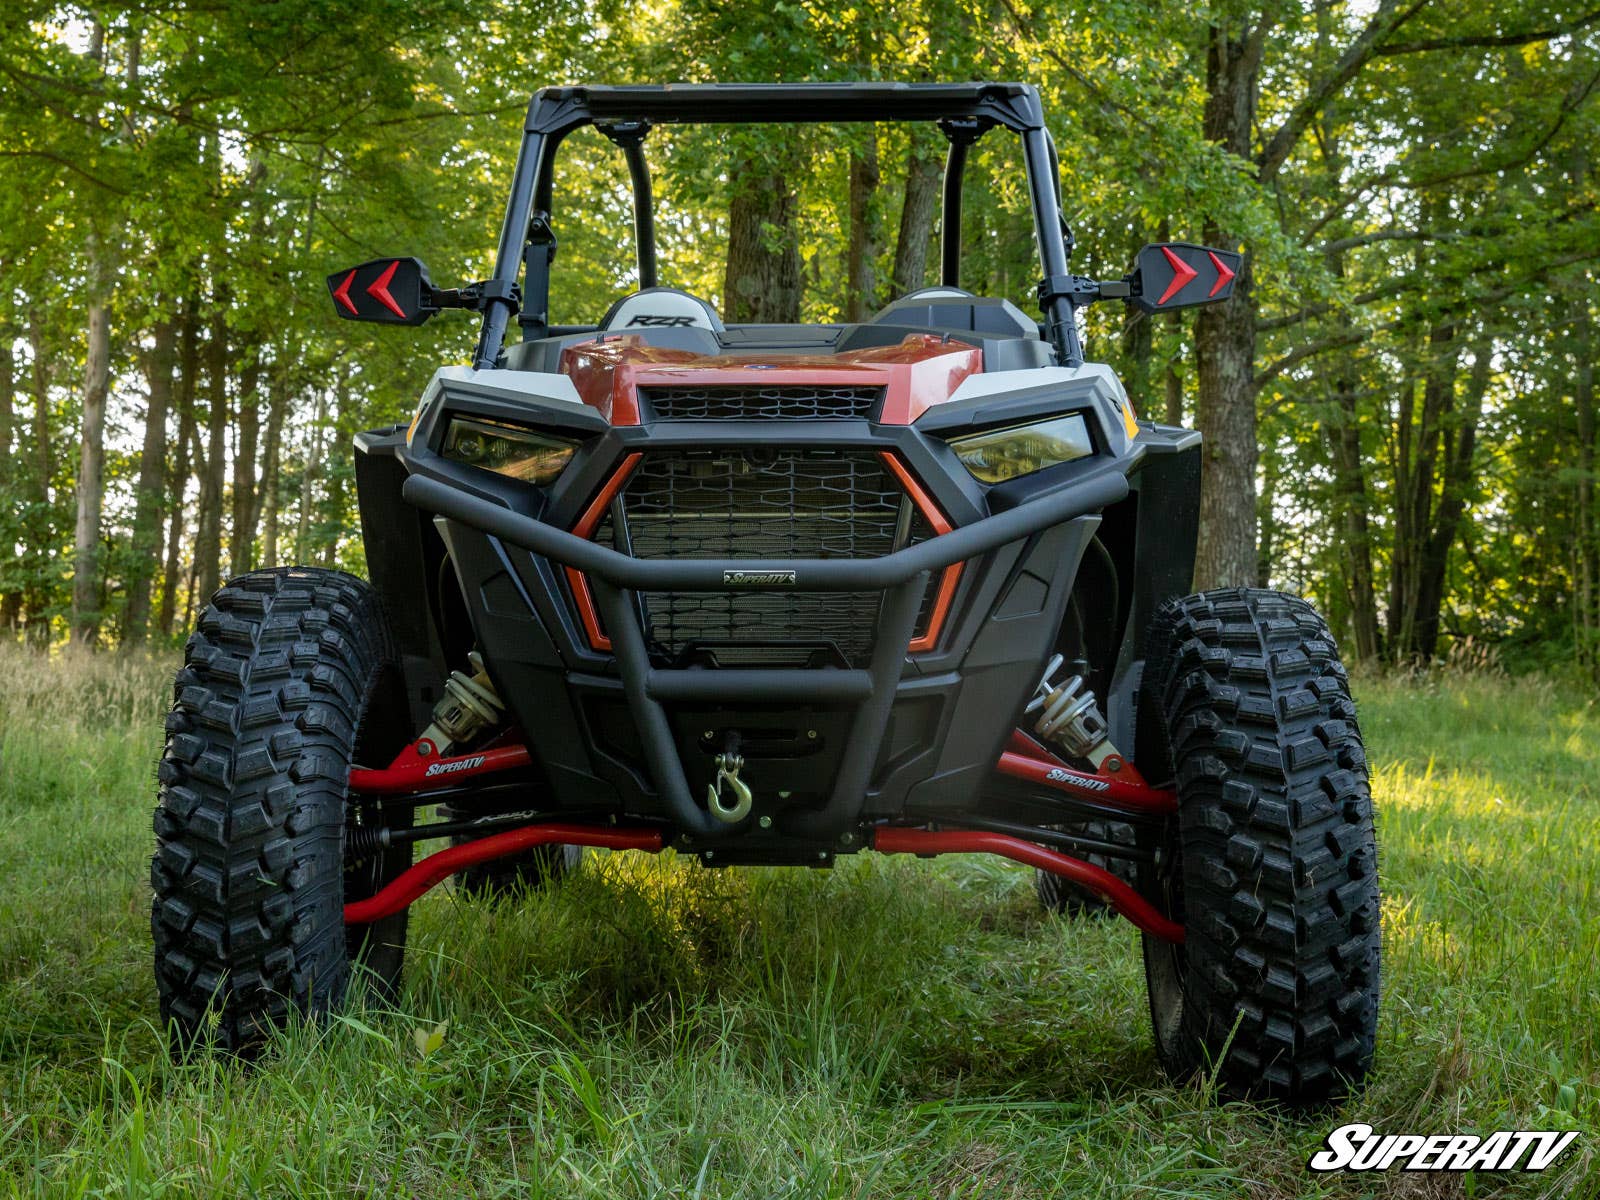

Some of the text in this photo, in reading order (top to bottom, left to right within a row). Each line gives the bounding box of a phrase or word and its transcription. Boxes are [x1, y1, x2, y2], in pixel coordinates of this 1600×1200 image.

[625, 315, 697, 327] RZR
[425, 756, 485, 776] SUPERATV
[1046, 769, 1110, 791] SUPERATV
